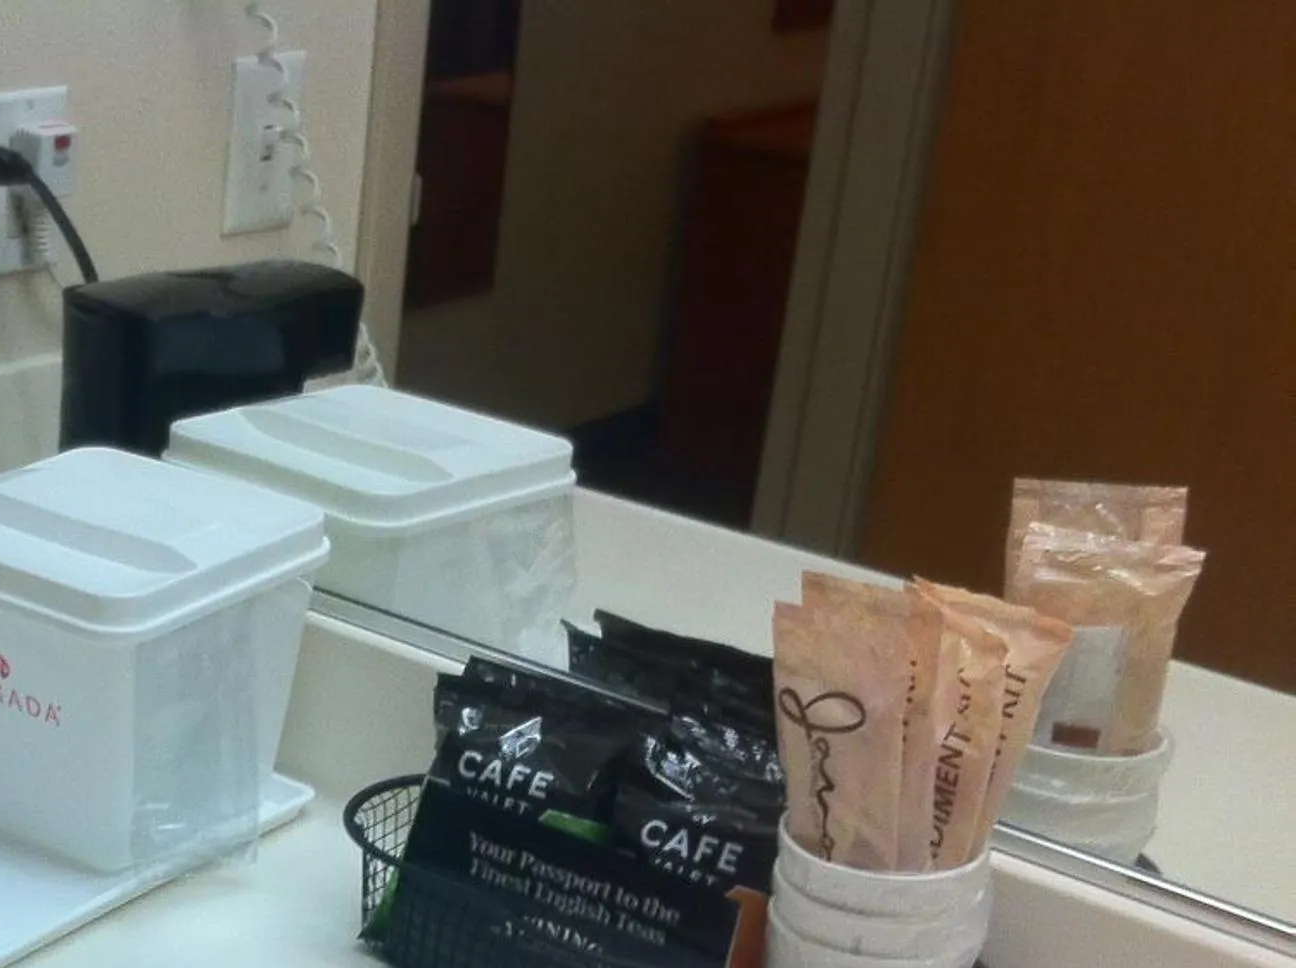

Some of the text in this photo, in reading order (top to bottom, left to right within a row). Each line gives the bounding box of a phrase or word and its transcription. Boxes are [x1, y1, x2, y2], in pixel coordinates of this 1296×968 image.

[458, 750, 554, 799] CAFE
[469, 830, 681, 928] Your Passport to the
[640, 819, 743, 873] CAFE
[470, 857, 667, 946] Finest English Teas
